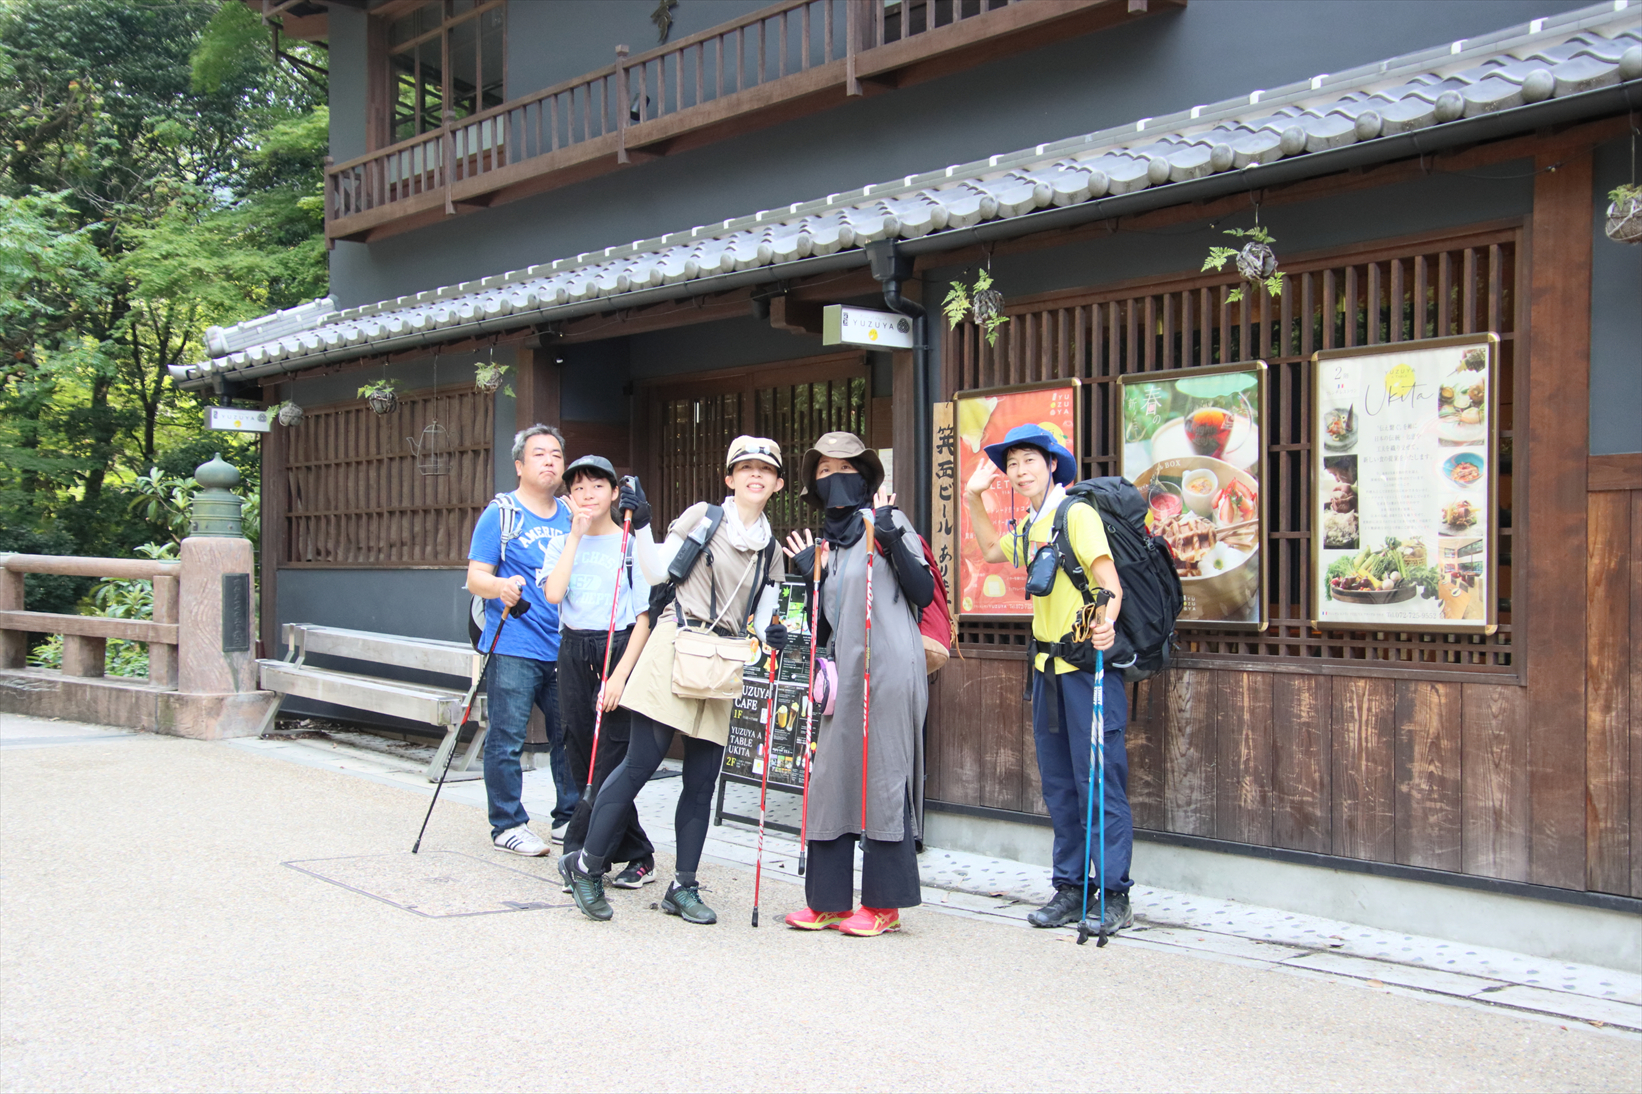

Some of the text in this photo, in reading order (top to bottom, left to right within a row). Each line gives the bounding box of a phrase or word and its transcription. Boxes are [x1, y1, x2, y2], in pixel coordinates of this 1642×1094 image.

[853, 320, 894, 330] YUZUYA
[1140, 384, 1162, 425] 春の
[1364, 381, 1434, 417] Ukita
[1164, 460, 1181, 468] BOX
[575, 575, 594, 589] 67
[734, 698, 758, 711] CAFE
[733, 709, 743, 719] 1F
[731, 725, 756, 738] YUZUYA
[757, 731, 762, 739] A
[730, 735, 753, 747] TABLE
[728, 744, 751, 757] UKITA
[726, 756, 736, 766] 2F
